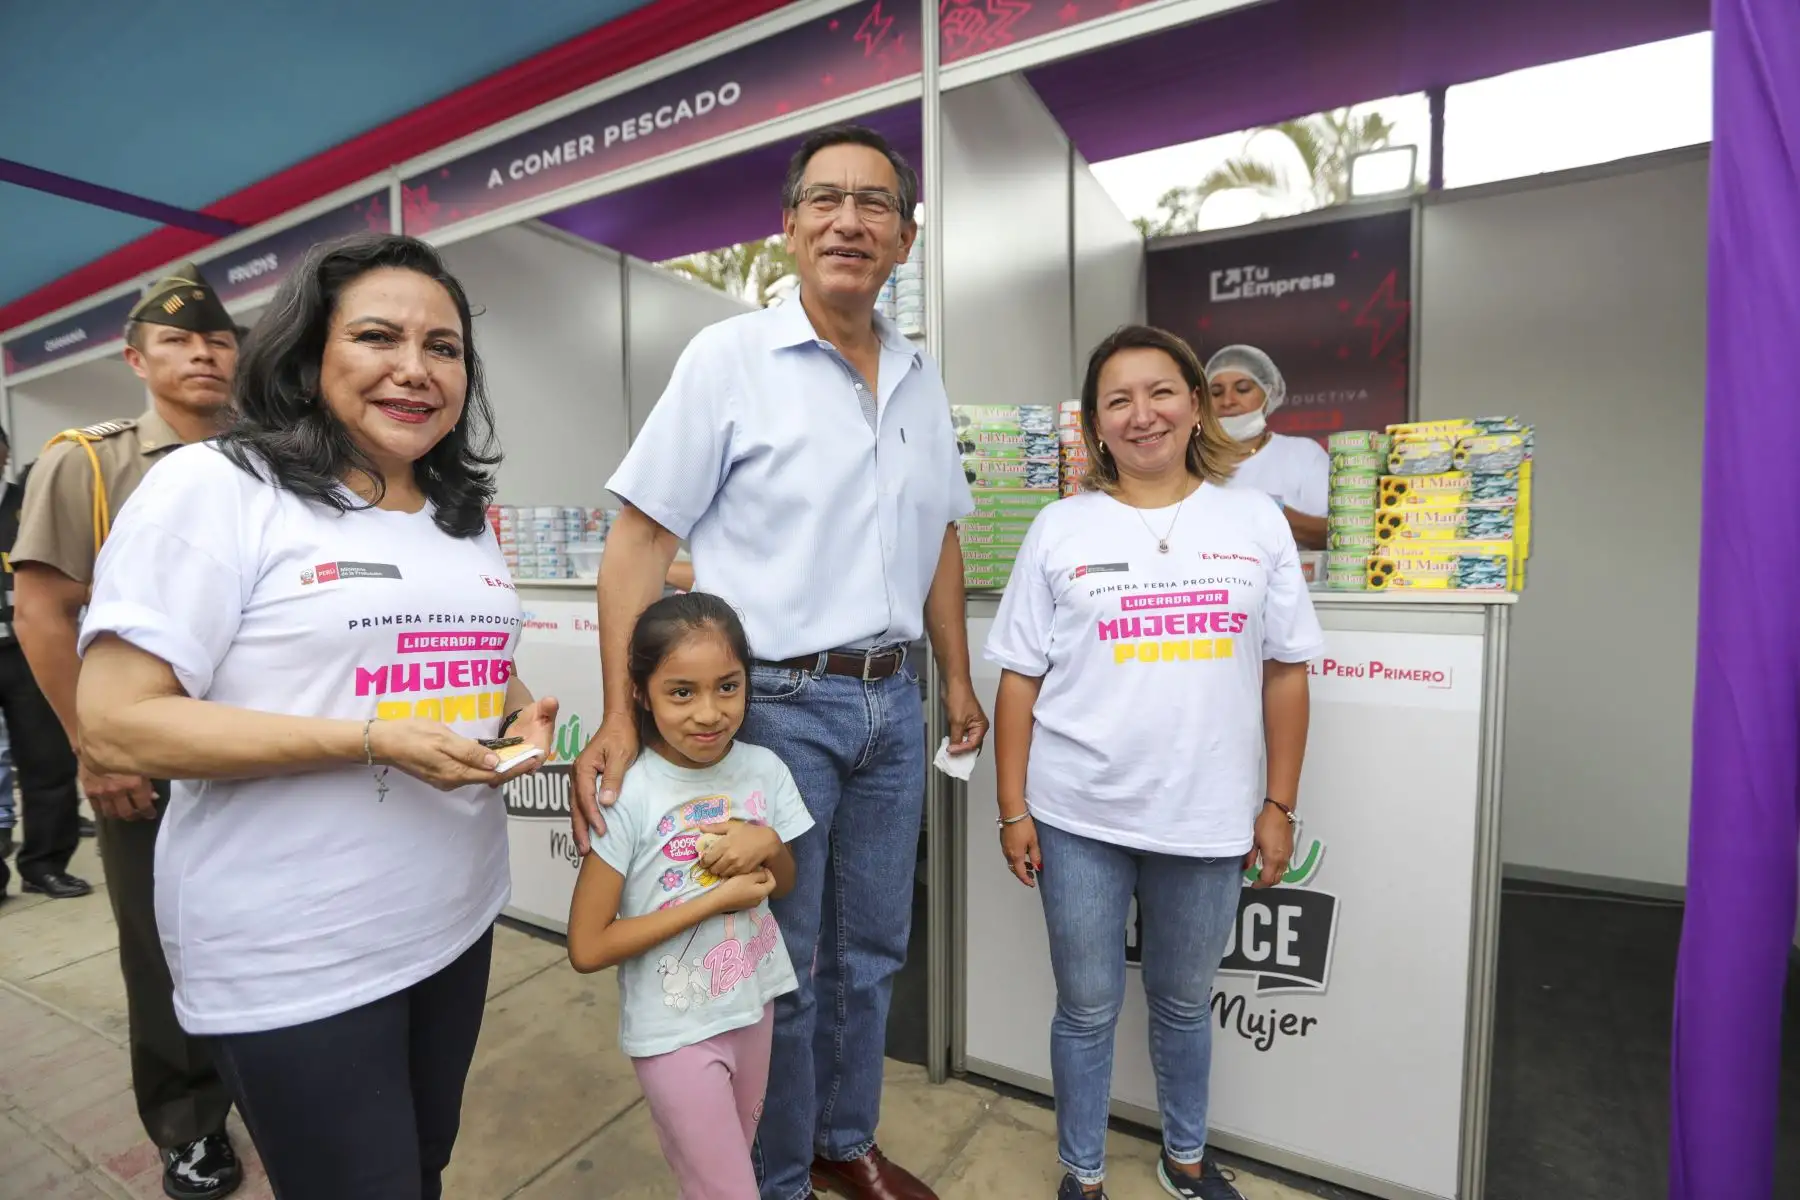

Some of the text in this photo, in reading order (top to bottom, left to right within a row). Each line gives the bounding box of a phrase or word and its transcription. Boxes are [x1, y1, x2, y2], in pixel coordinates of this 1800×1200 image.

[487, 82, 741, 189] A COMER PESCADO
[1242, 272, 1335, 298] Empresa
[1243, 266, 1269, 281] Tu
[1089, 576, 1254, 597] PRIMERA FERIA PRODUCTIVA
[1125, 593, 1223, 608] LIDERADA POR
[349, 614, 421, 630] PRIMERA
[428, 614, 465, 623] FERIA
[1098, 612, 1248, 641] MUJERES
[404, 636, 504, 649] LIDERADA POR
[1114, 638, 1234, 664] POWER
[1323, 658, 1364, 678] PERÚ
[1369, 661, 1445, 682] PRIMERO
[1210, 987, 1317, 1052] Mujer
